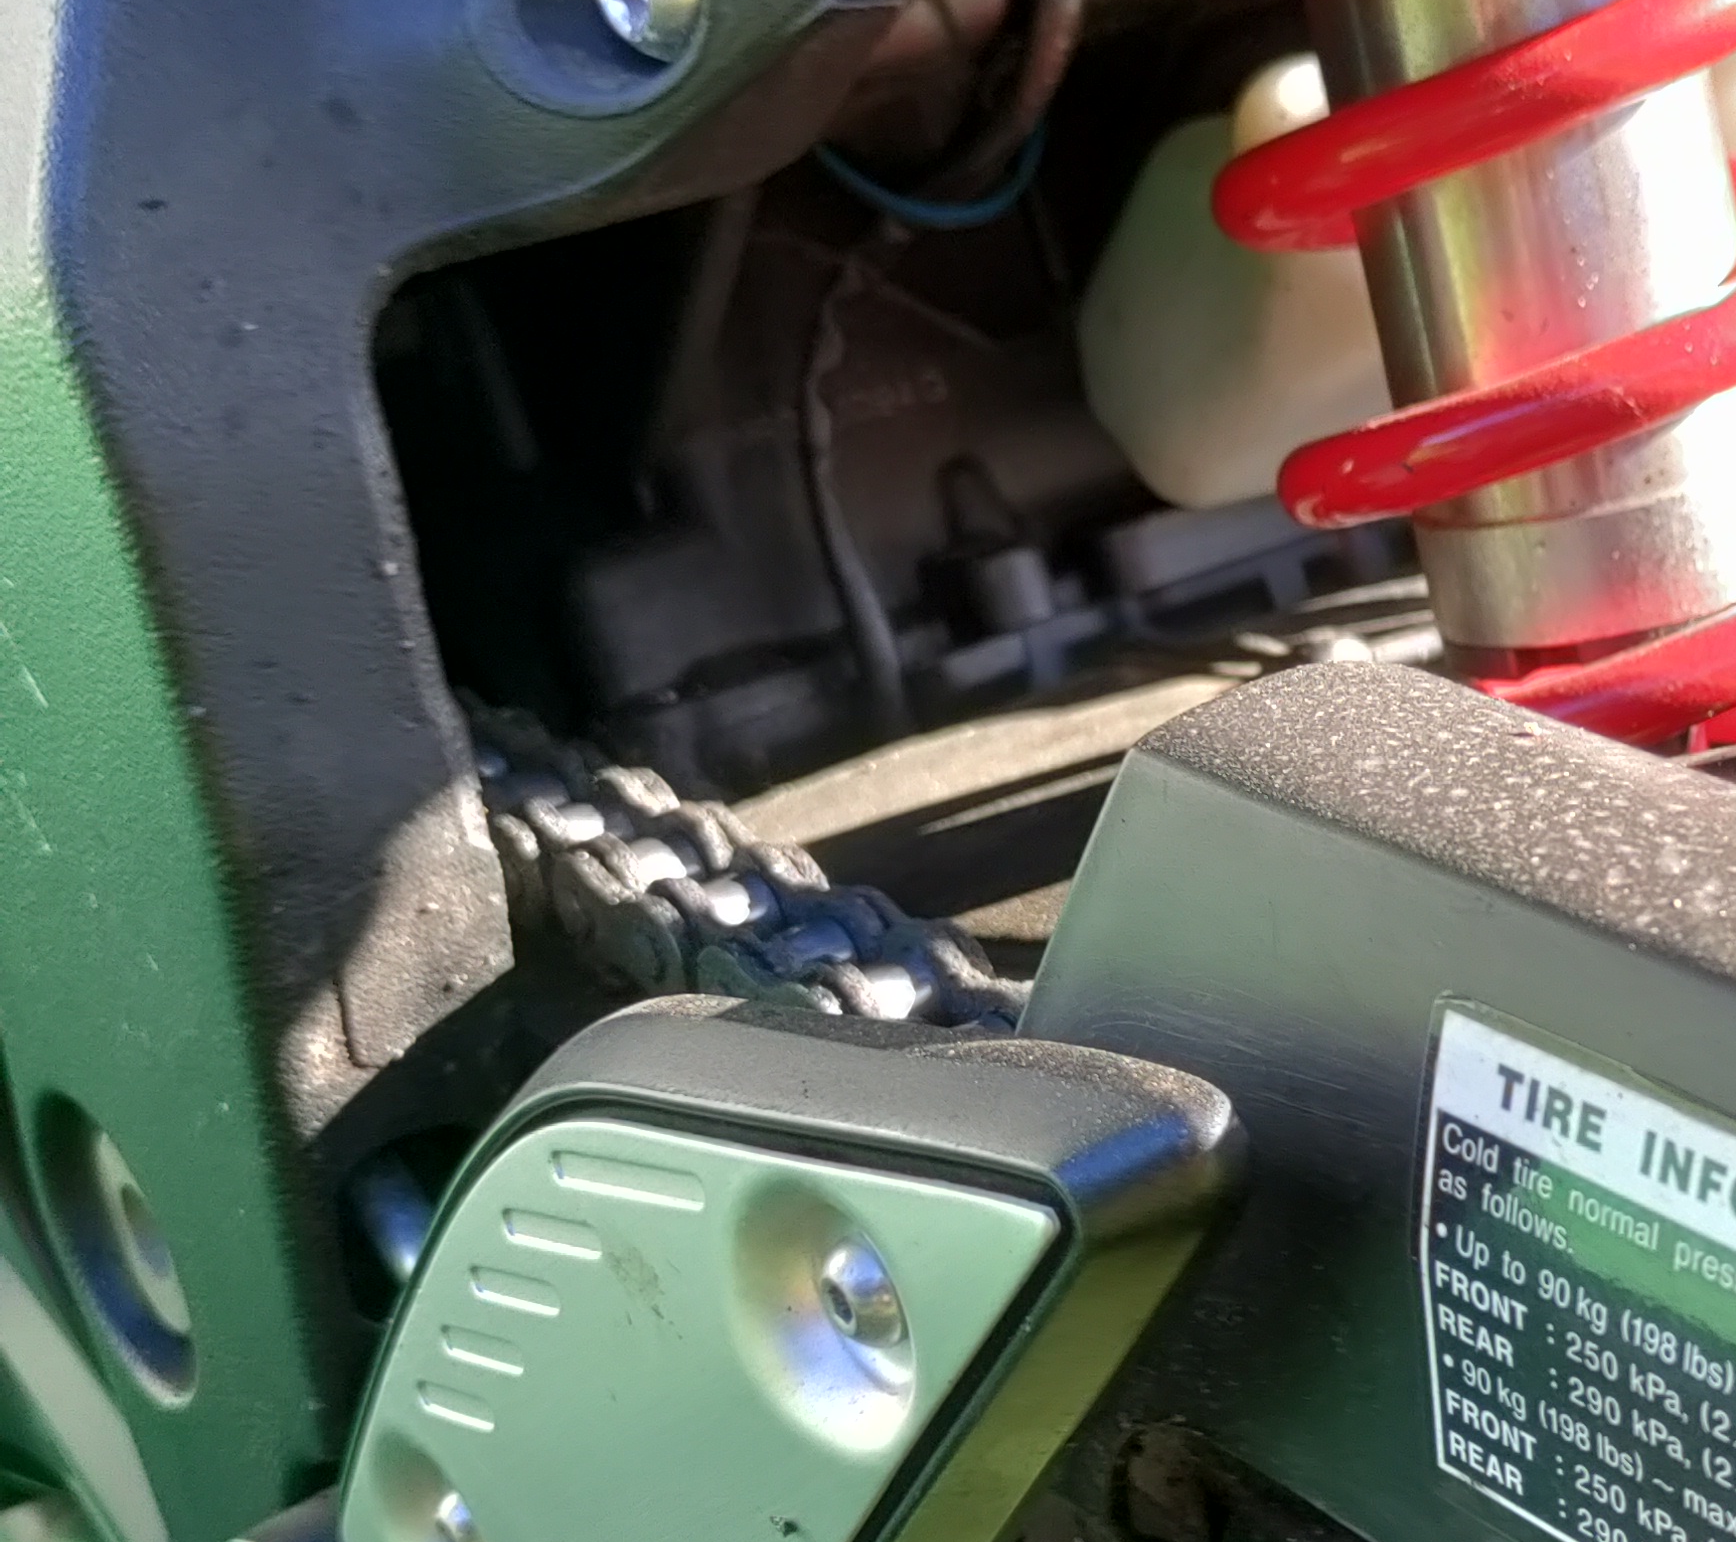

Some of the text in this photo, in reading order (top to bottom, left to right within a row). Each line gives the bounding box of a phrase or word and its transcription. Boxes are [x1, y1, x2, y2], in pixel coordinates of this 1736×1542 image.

[1497, 1063, 1606, 1154] TIRE
[1438, 1168, 1574, 1255] as follows.
[1443, 1123, 1500, 1175] Cold
[1513, 1157, 1554, 1198] tire
[1569, 1191, 1660, 1251] normal
[1434, 1259, 1528, 1331] FRONT
[1565, 1331, 1619, 1382] 250
[1629, 1363, 1690, 1425] kPa,
[1455, 1224, 1489, 1270] Up
[1502, 1249, 1526, 1286] to
[1538, 1269, 1571, 1309] 90
[1576, 1286, 1608, 1335] kg
[1621, 1309, 1677, 1365] (198
[1682, 1341, 1734, 1395] lbs)
[1438, 1303, 1515, 1369] REAR
[1568, 1376, 1622, 1427] 290
[1631, 1409, 1692, 1471] kPa,
[1461, 1359, 1492, 1396] 90
[1497, 1377, 1527, 1422] kg
[1539, 1400, 1592, 1453] (198
[1596, 1432, 1644, 1484] lbs)
[1446, 1388, 1537, 1461] FRONT
[1574, 1464, 1627, 1515] 250
[1449, 1430, 1524, 1496] REAR
